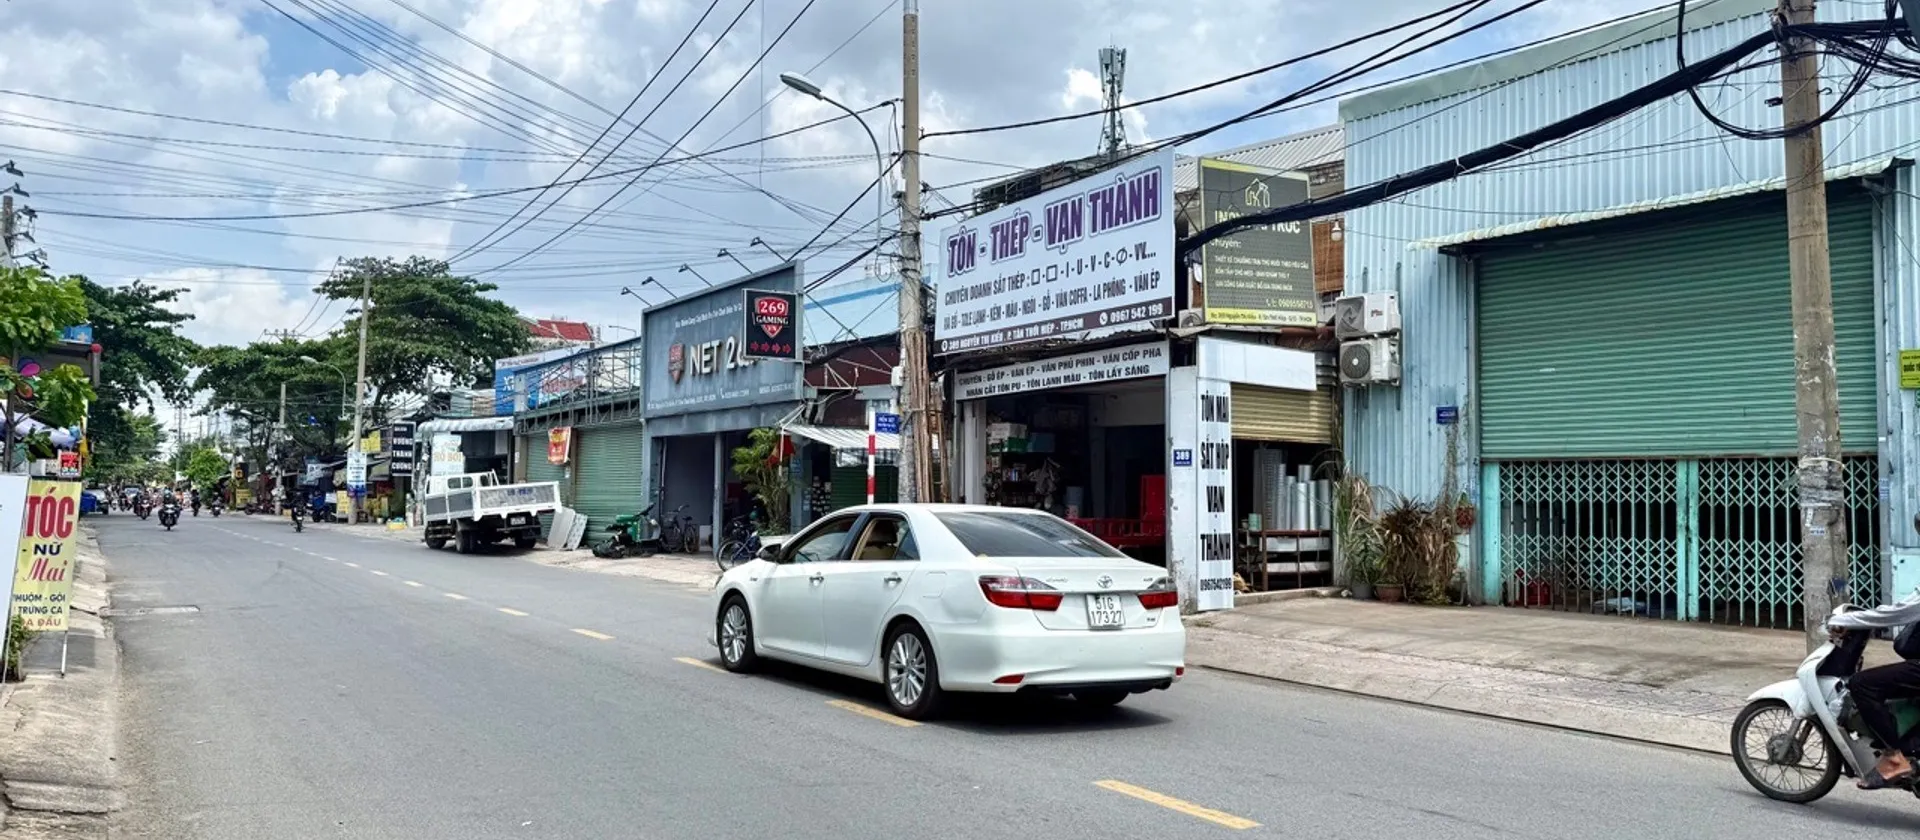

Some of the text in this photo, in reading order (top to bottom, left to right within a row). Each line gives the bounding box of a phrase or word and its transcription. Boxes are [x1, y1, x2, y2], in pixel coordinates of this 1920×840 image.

[948, 174, 1160, 274] TÔN THÉP VẠN THÀNH
[945, 285, 969, 306] CHUYÊN
[969, 281, 993, 301] DOANH
[993, 273, 1006, 295] SẮT
[756, 315, 789, 325] GAMING
[760, 300, 786, 314] 269
[1110, 303, 1163, 322] 0967 542 199
[689, 339, 721, 376] NET
[1075, 357, 1095, 368] PHIN
[1142, 347, 1162, 359] PHA
[1011, 382, 1021, 391] PU
[1042, 375, 1062, 388] LẠNH
[1201, 389, 1214, 422] TÔN
[1201, 434, 1214, 469] SẮT
[25, 486, 75, 539] TÓC
[1206, 486, 1225, 518] VẠN
[33, 541, 63, 556] NỮ
[1200, 528, 1231, 561] THÀNH
[22, 558, 68, 582] Mai
[1095, 597, 1114, 610] 51G
